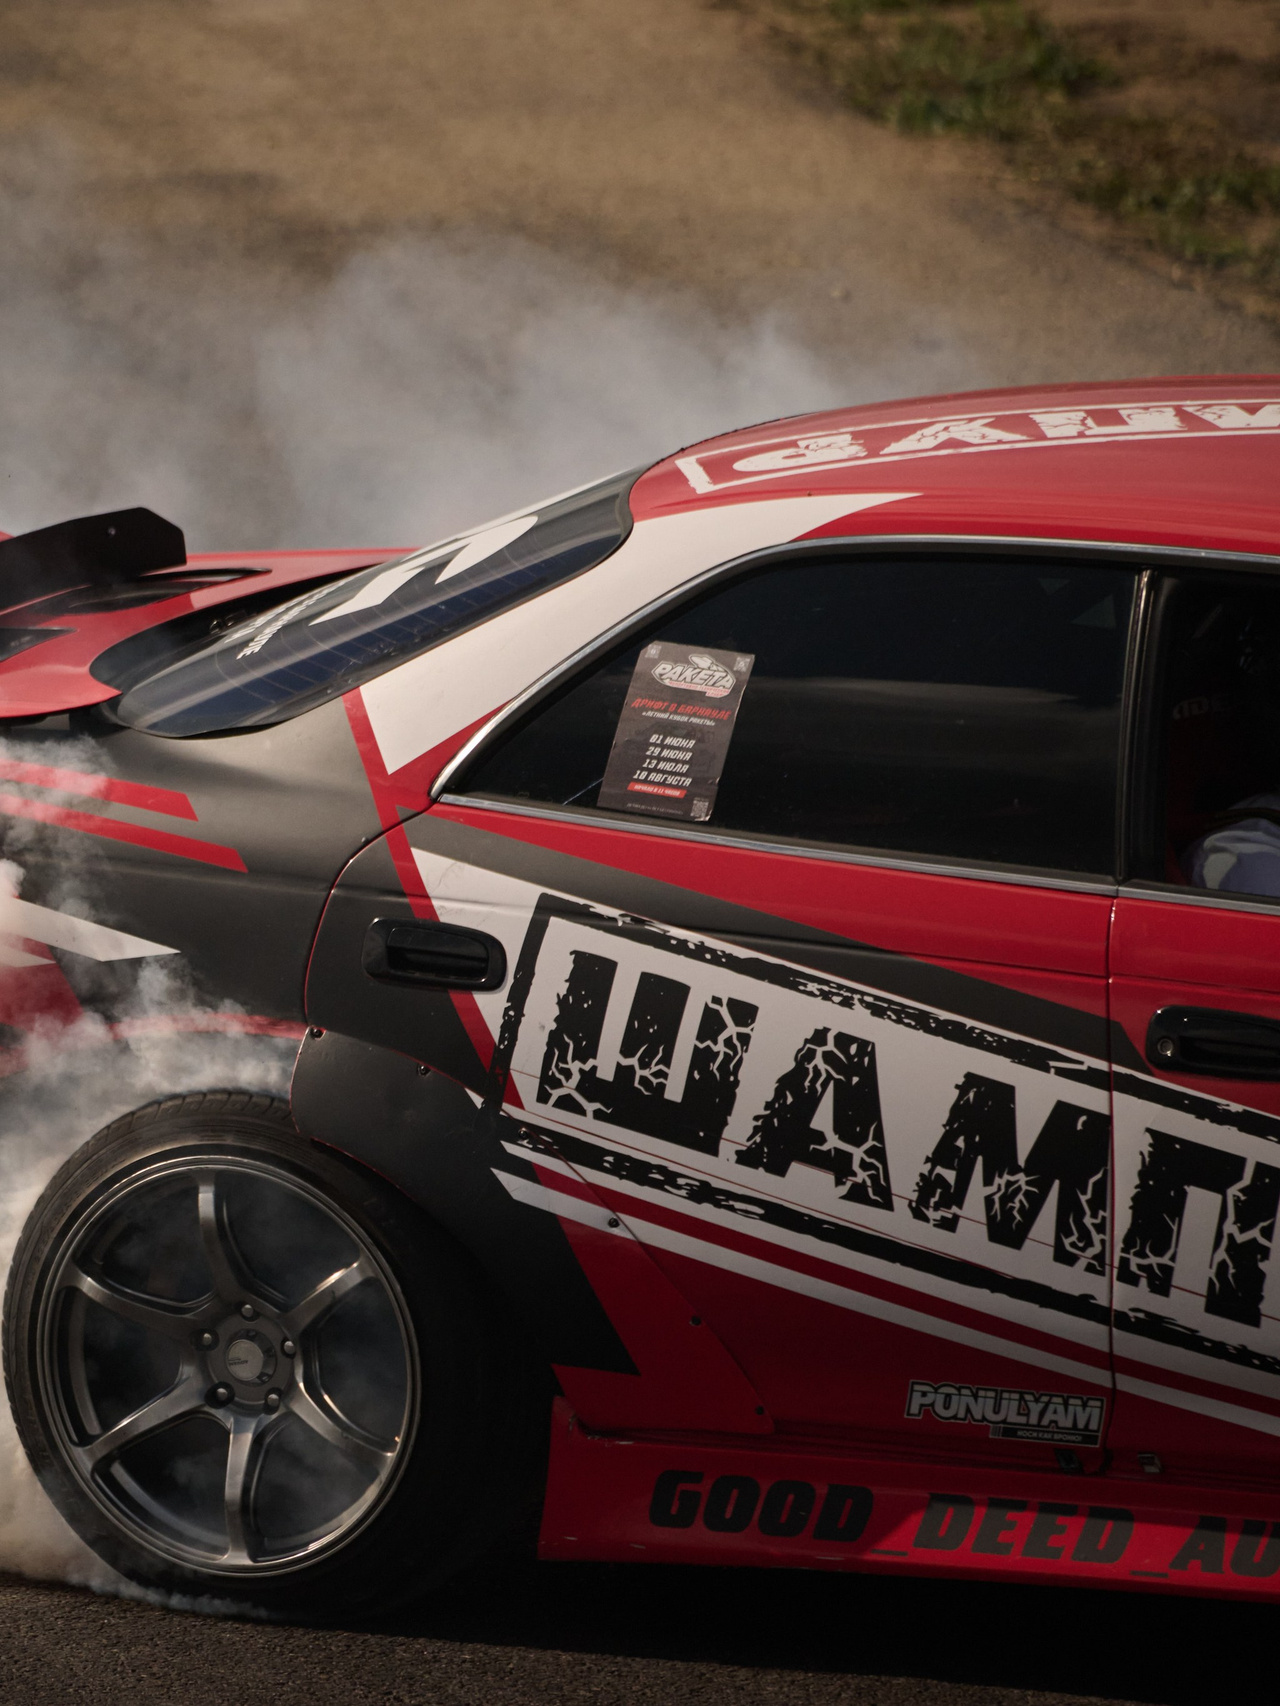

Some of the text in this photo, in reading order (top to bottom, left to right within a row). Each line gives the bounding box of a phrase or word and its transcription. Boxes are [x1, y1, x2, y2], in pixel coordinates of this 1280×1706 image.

[653, 663, 733, 689] РАКЕТА
[631, 698, 669, 711] ДРИФТ
[677, 704, 732, 720] БАРНАУЛЕ
[649, 734, 696, 748] 01 ИЮНЯ
[646, 747, 693, 761] 29 ИЮНЯ
[642, 759, 689, 773] 13 ИЮЛЯ
[648, 772, 692, 787] АВГУСТА
[536, 950, 1280, 1328] ШАМП
[907, 1382, 1103, 1431] PONULYAM
